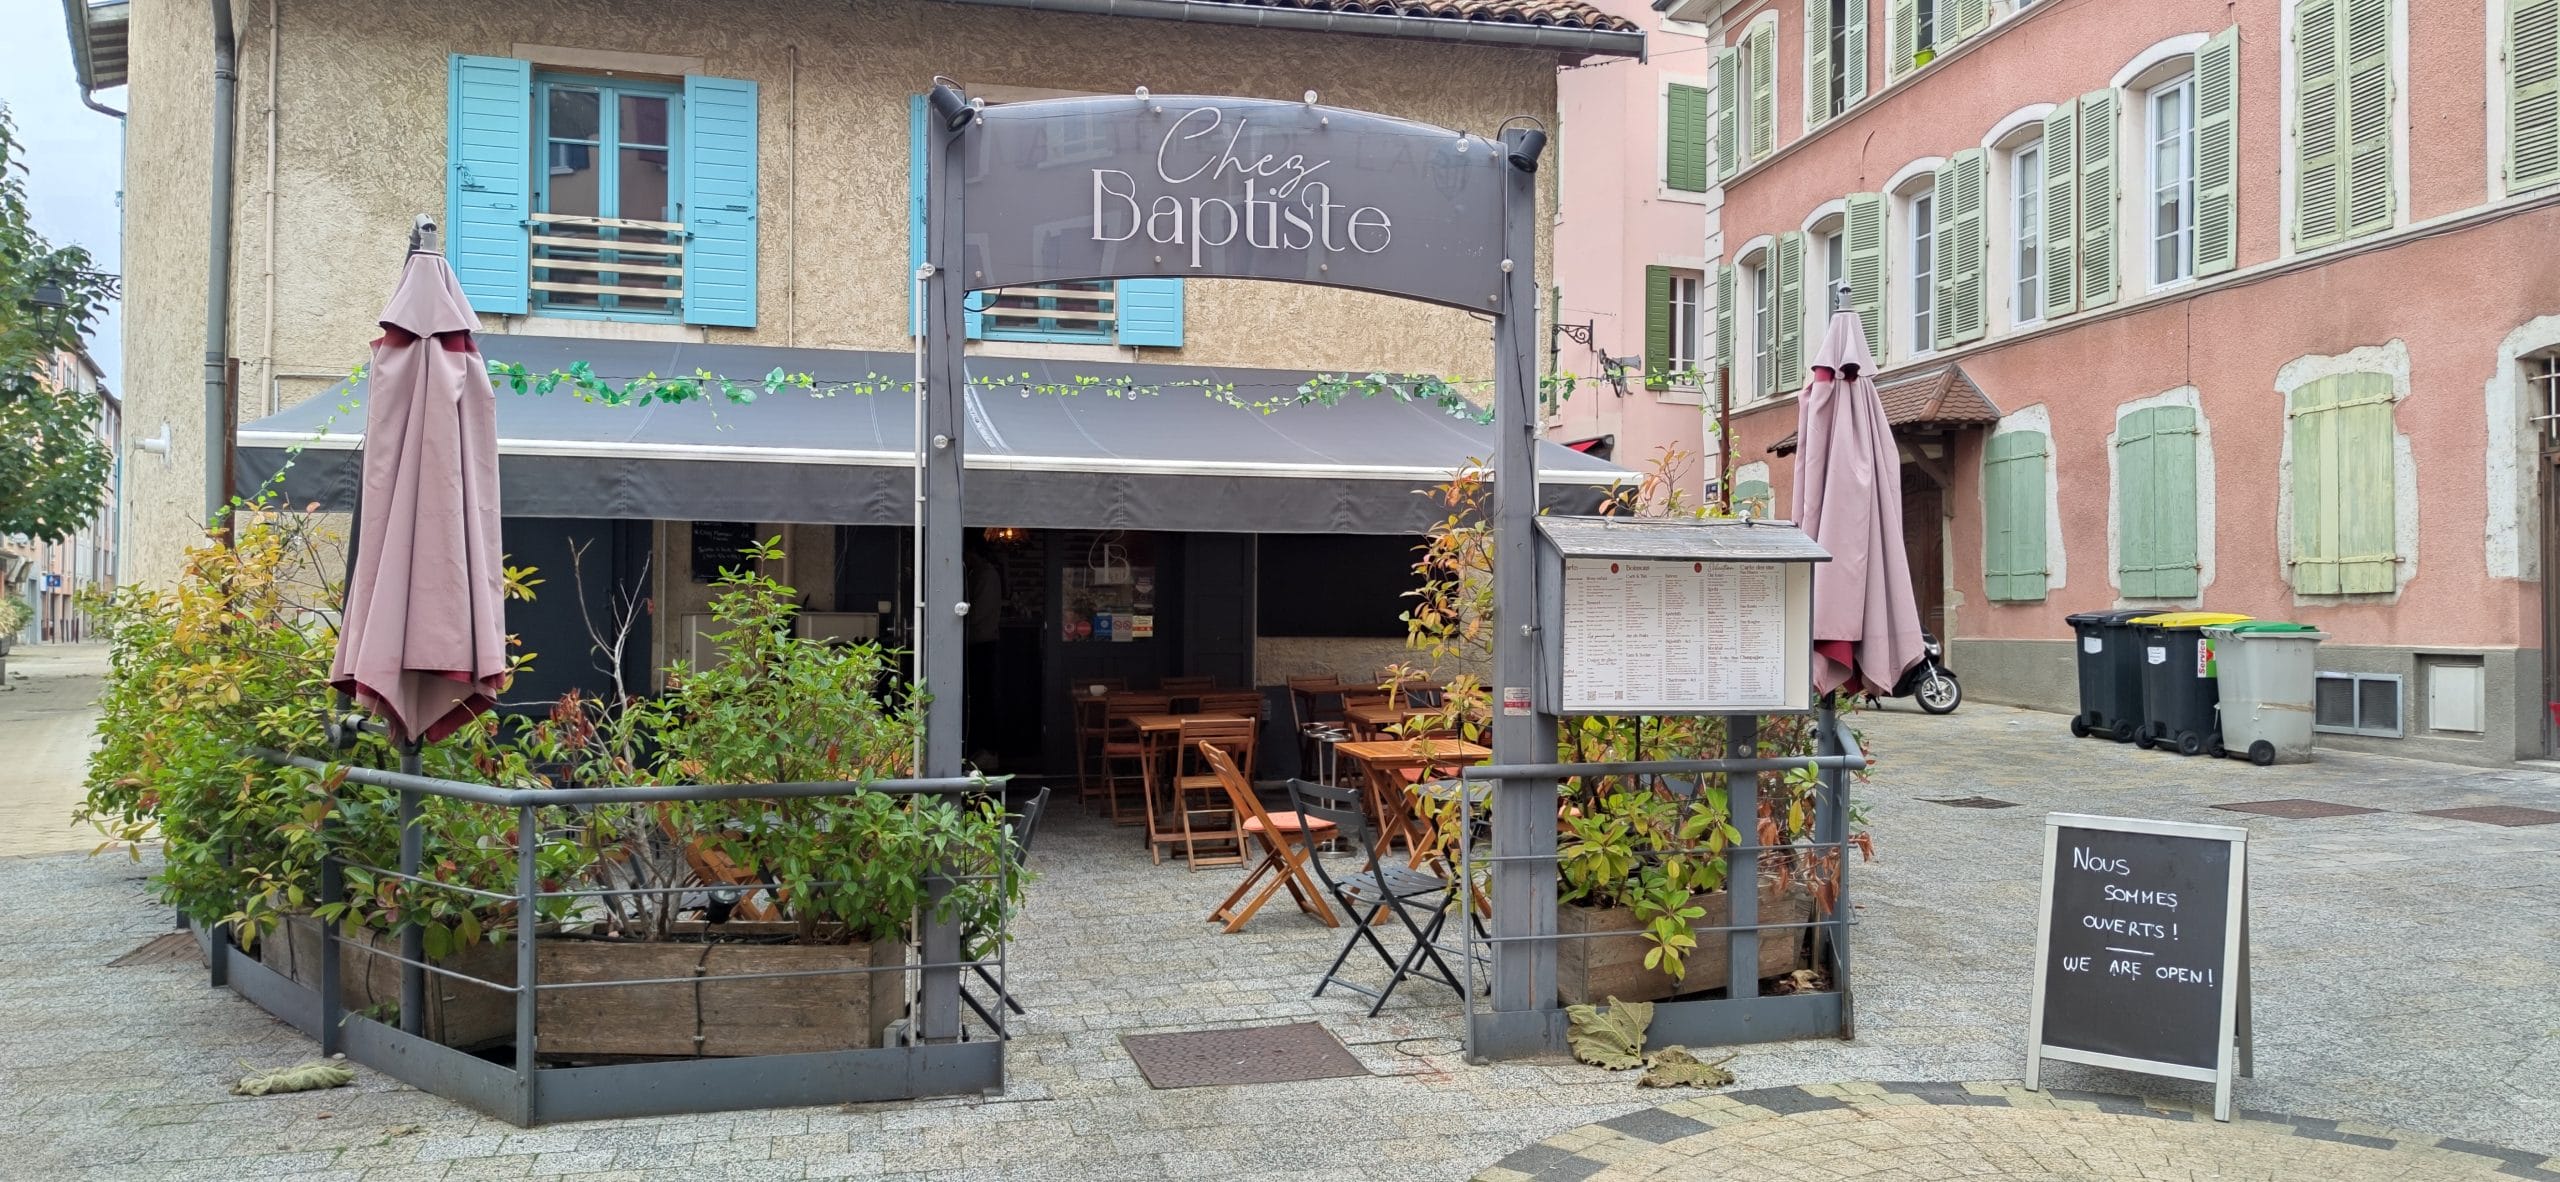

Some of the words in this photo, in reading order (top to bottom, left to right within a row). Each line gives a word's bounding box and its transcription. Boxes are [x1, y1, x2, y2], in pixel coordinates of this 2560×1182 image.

[1156, 106, 1330, 198] Chez
[1090, 167, 1392, 268] Baptiste
[2198, 640, 2206, 674] Service
[2104, 885, 2178, 908] SOMMES
[2063, 956, 2091, 972] WE
[2109, 959, 2142, 977] ARE
